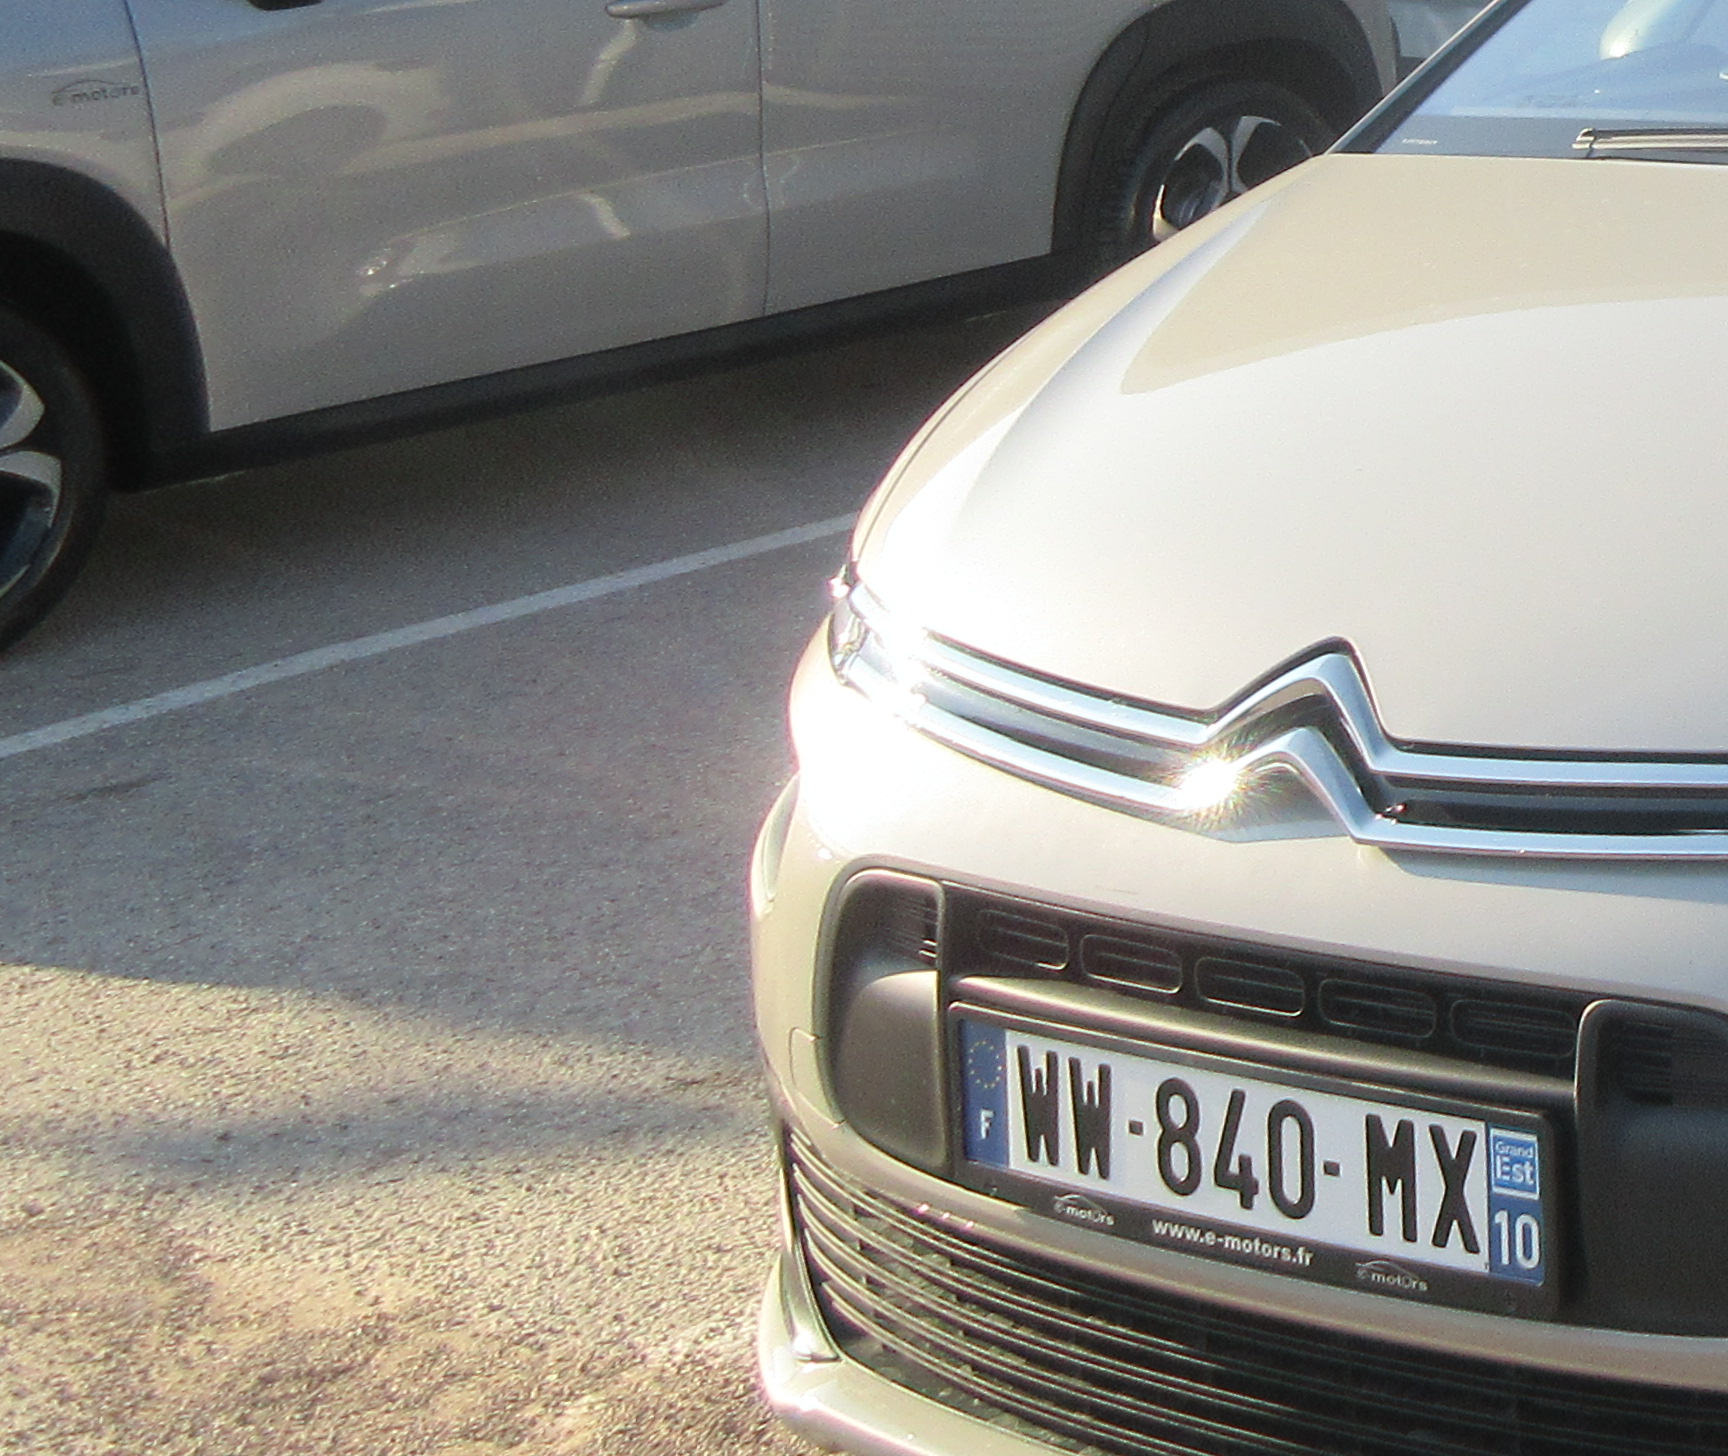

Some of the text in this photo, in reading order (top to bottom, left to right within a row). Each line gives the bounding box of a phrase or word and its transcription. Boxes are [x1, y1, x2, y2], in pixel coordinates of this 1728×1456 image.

[51, 86, 139, 106] emotors
[979, 1108, 995, 1140] F
[1495, 1141, 1534, 1159] Grand
[1496, 1155, 1534, 1185] Est
[1153, 1219, 1315, 1267] www.e-motors.fr
[1494, 1209, 1540, 1269] 10
